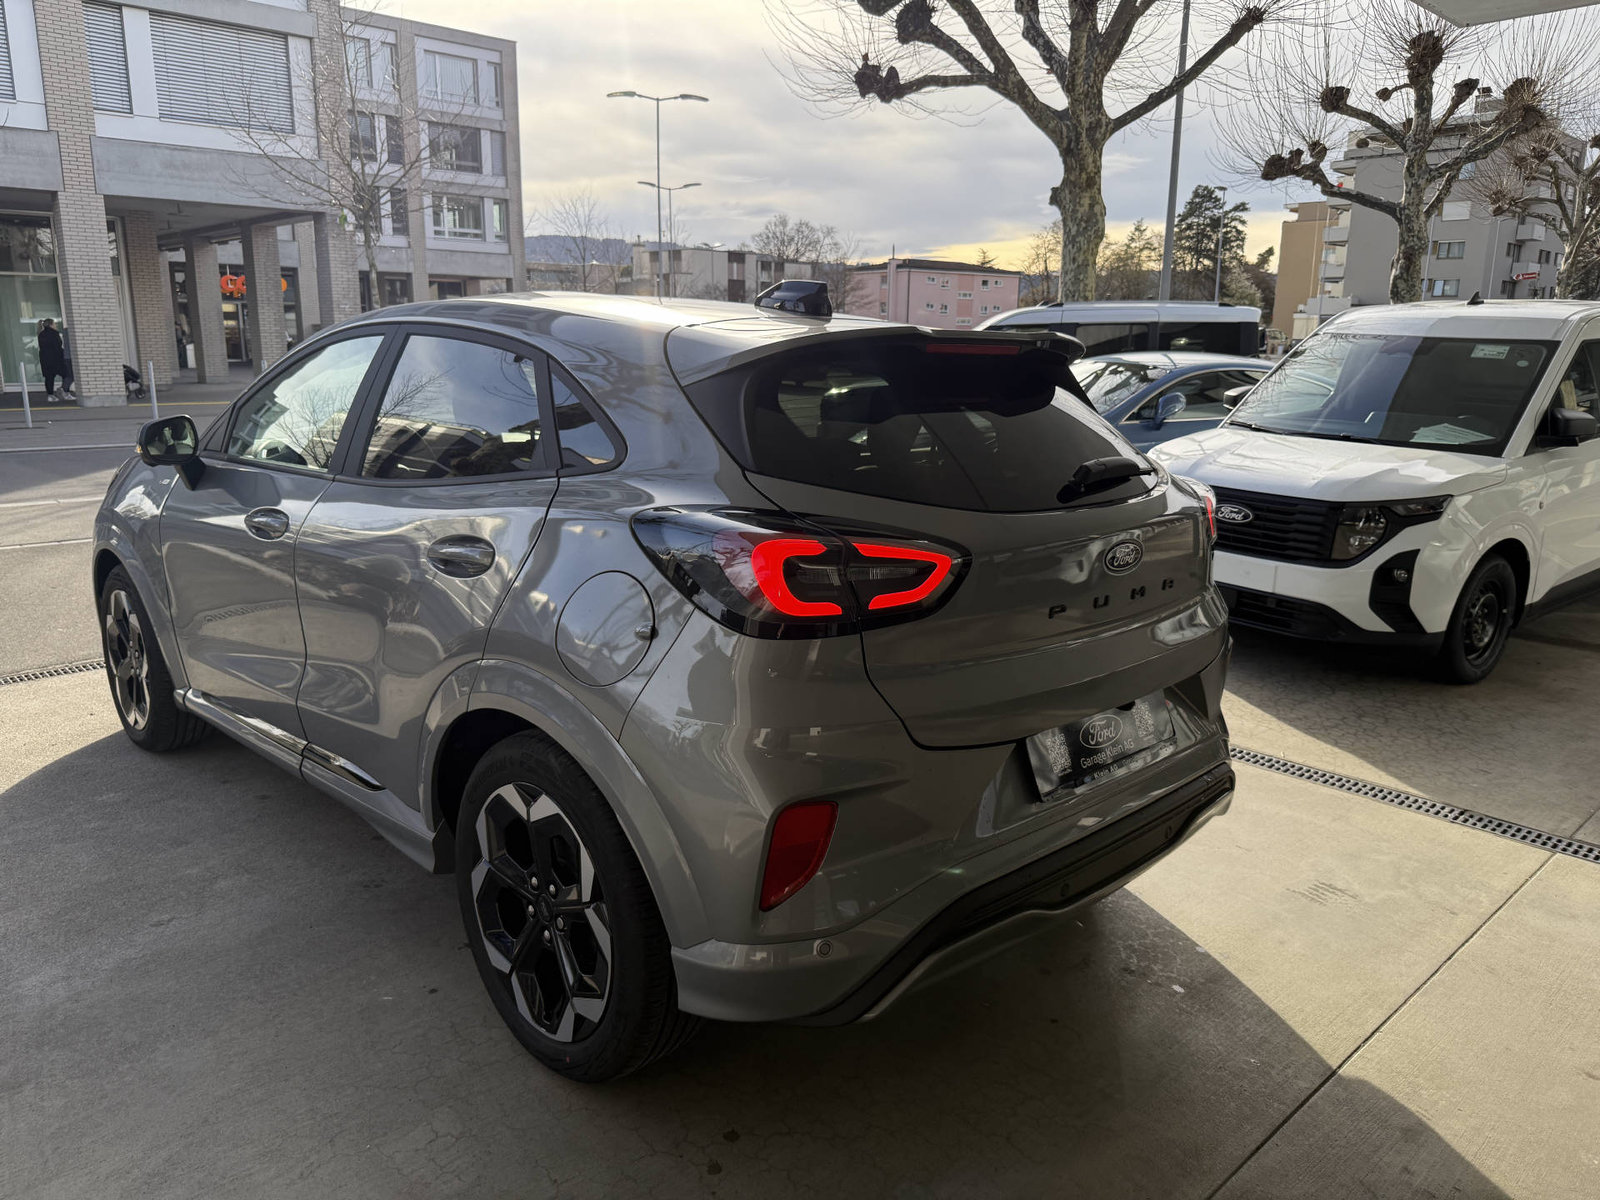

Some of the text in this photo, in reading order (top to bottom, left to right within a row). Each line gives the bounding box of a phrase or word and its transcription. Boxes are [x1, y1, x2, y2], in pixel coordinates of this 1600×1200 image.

[1217, 506, 1245, 520] Ford
[1048, 578, 1175, 619] PUMA
[1089, 720, 1116, 745] Ford
[1080, 752, 1106, 769] Garage
[1105, 744, 1124, 758] Klein
[1123, 738, 1135, 751] AG
